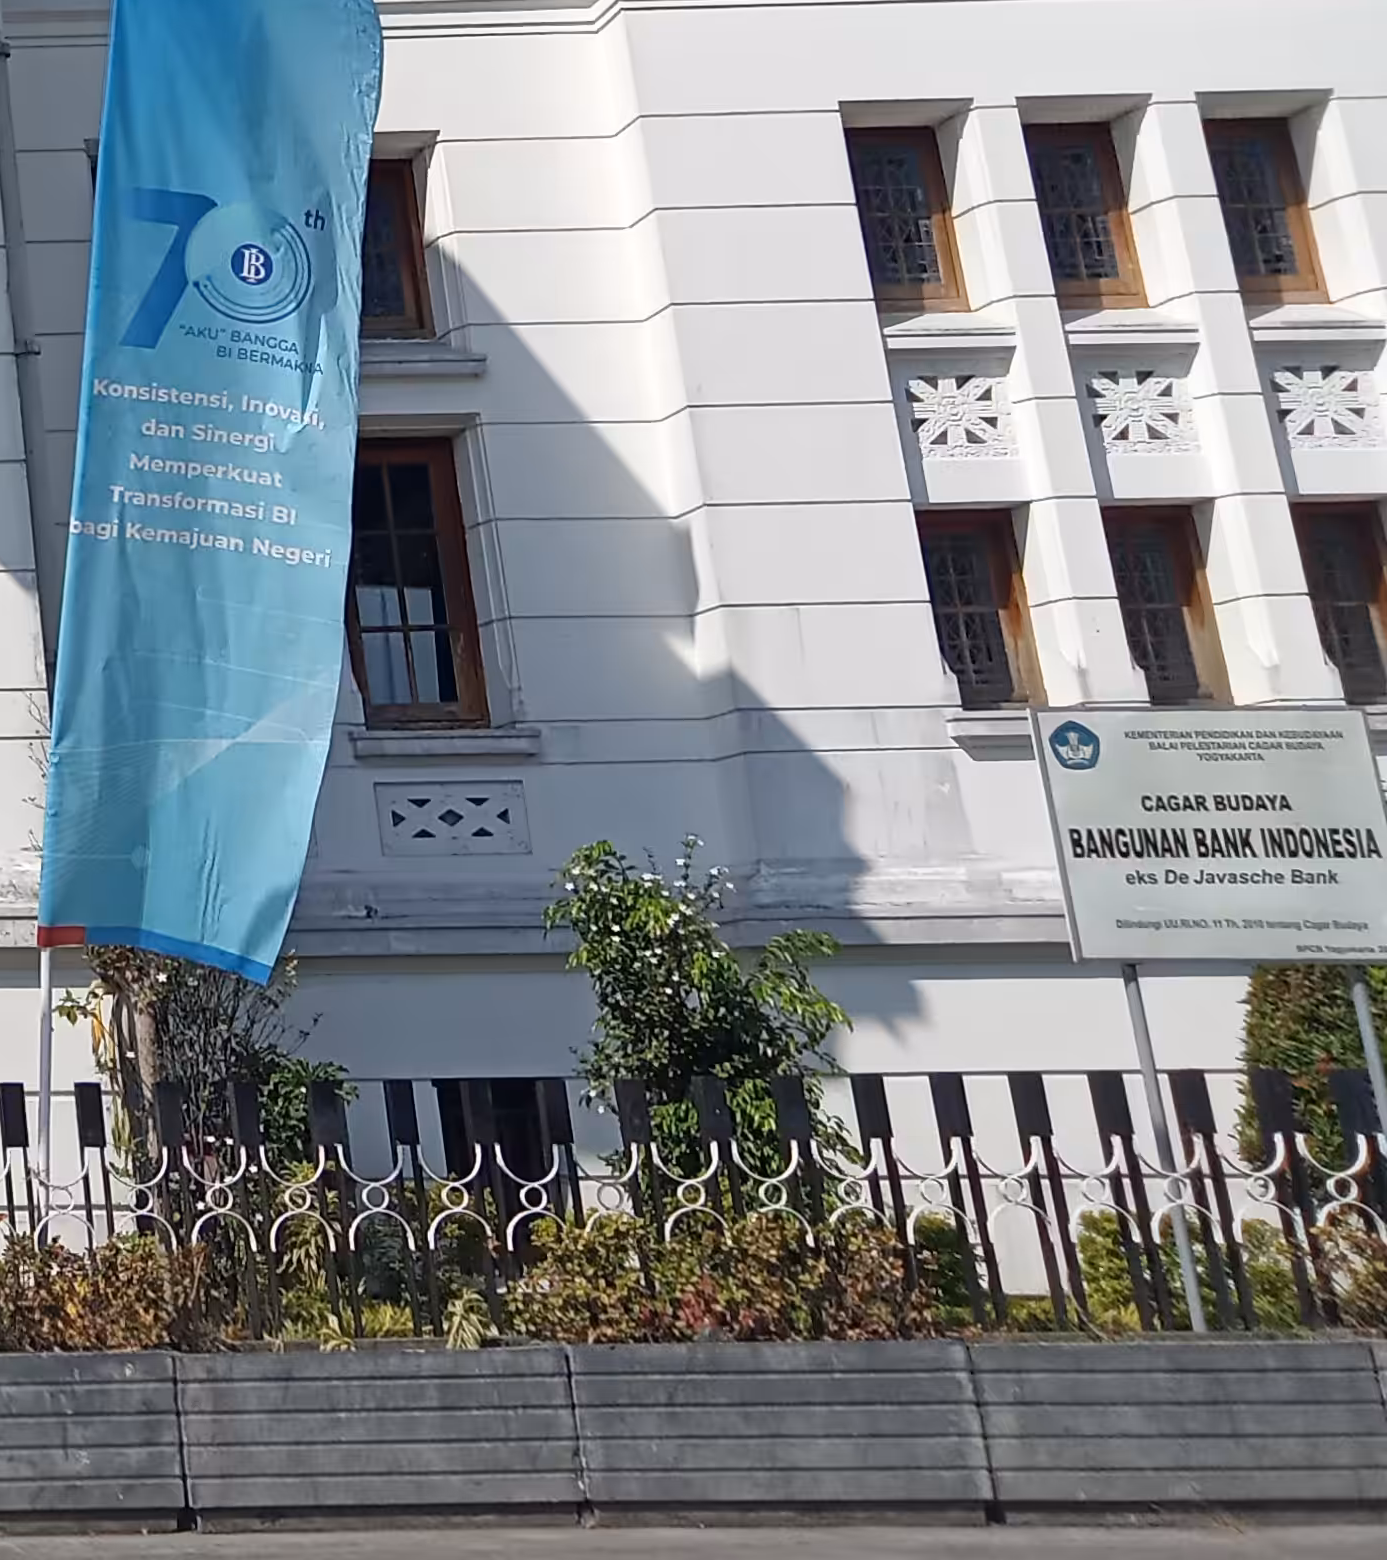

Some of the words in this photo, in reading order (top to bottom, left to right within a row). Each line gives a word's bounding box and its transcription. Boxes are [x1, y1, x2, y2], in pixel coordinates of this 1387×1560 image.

[304, 208, 327, 232] th
[230, 330, 300, 355] BANGGA
[216, 345, 232, 358] BI
[236, 348, 324, 375] BERMAKNA
[93, 378, 234, 413] Konsistensi,
[141, 419, 185, 440] dan
[191, 423, 275, 453] Sinergi
[129, 453, 283, 488] Memperkuat
[109, 485, 265, 520] Transformasi
[271, 506, 297, 525] BI
[125, 522, 245, 552] Kemajuan
[252, 537, 332, 569] Negeri
[1149, 741, 1178, 751] BALAI
[1255, 730, 1277, 740] DAN
[1196, 751, 1265, 762] YOGYAKARTA
[1140, 794, 1209, 812] CAGAR
[1213, 794, 1293, 812] BUDAYA
[1068, 827, 1190, 859] BANGUNAN
[1192, 827, 1259, 859] BANK
[1259, 827, 1383, 859] INDONESIA
[1125, 869, 1158, 886] eks
[1164, 869, 1189, 885] De
[1193, 869, 1285, 885] Javasche
[1290, 869, 1339, 885] Bank
